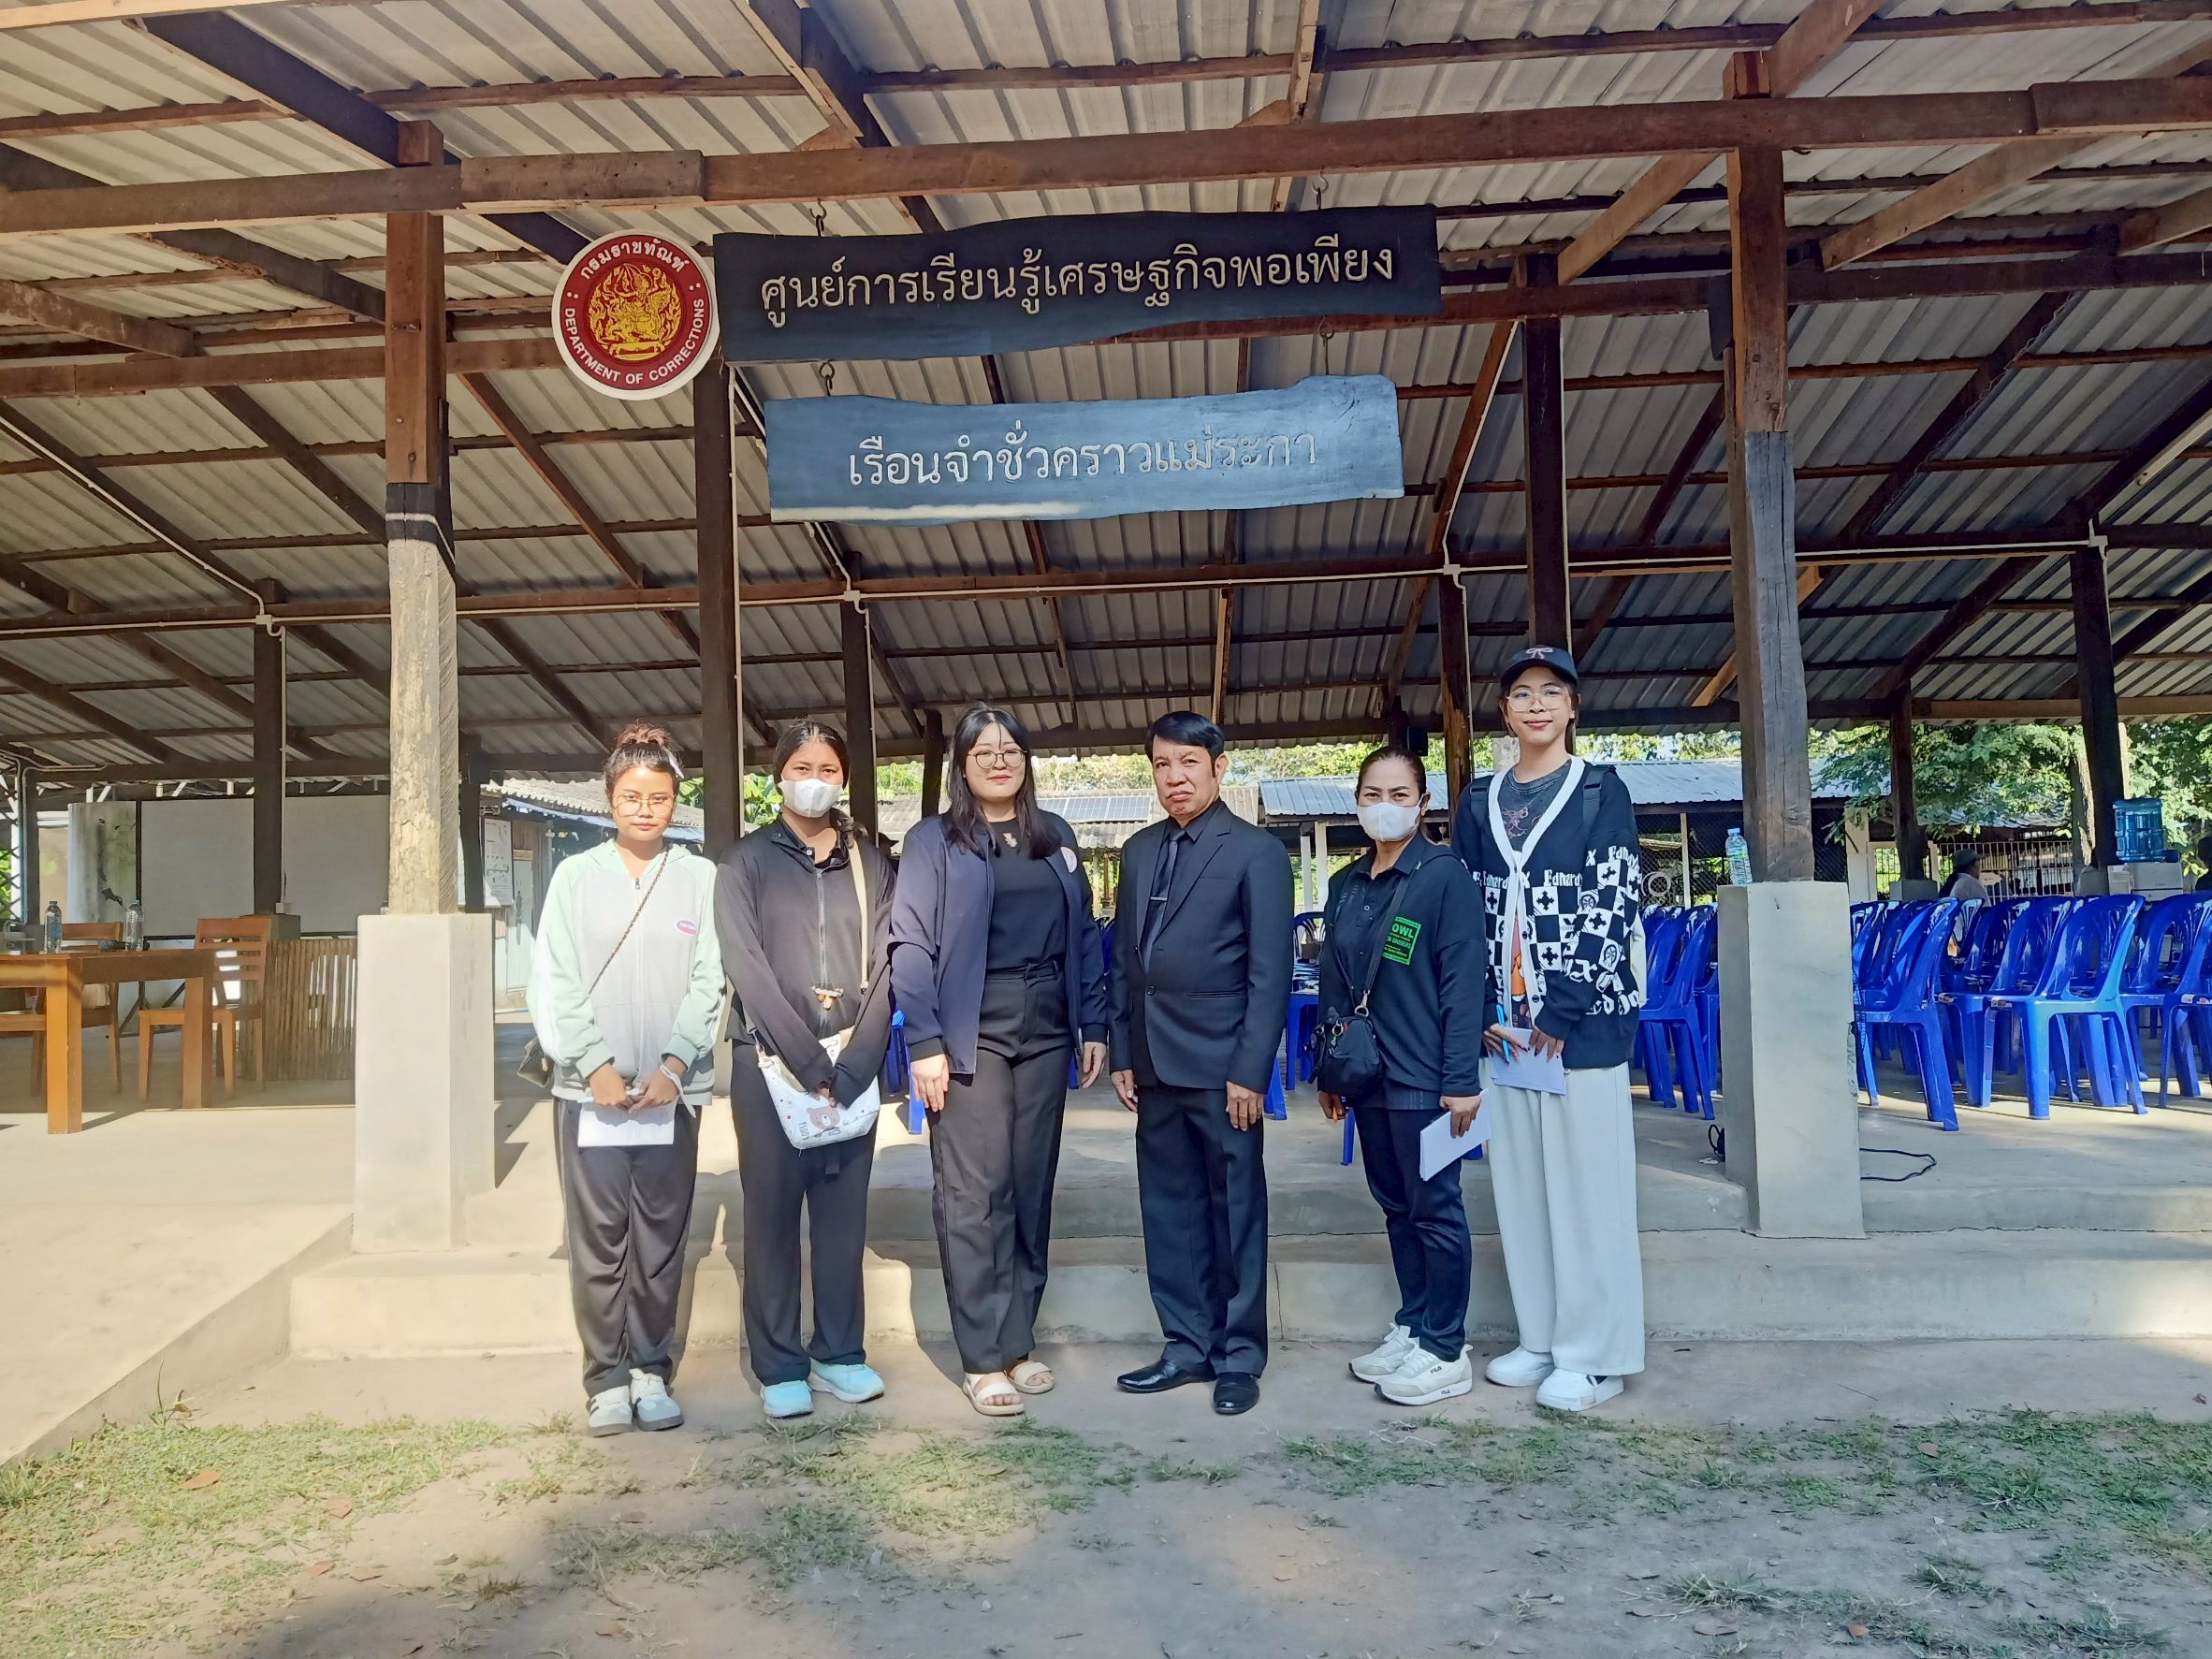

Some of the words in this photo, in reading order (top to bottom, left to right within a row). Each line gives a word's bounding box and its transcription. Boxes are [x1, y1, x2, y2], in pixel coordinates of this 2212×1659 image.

[580, 239, 690, 280] กรมราชทัณฑ์
[761, 233, 1393, 328] ศูนย์การเรียนรู้เศรษฐกิจพอเพียง
[565, 307, 621, 383] DEPARTMENT
[625, 372, 644, 385] OF
[648, 298, 705, 382] CORRECTIONS
[849, 419, 1317, 486] เรือนจำชั่วคราวแม่ระกา
